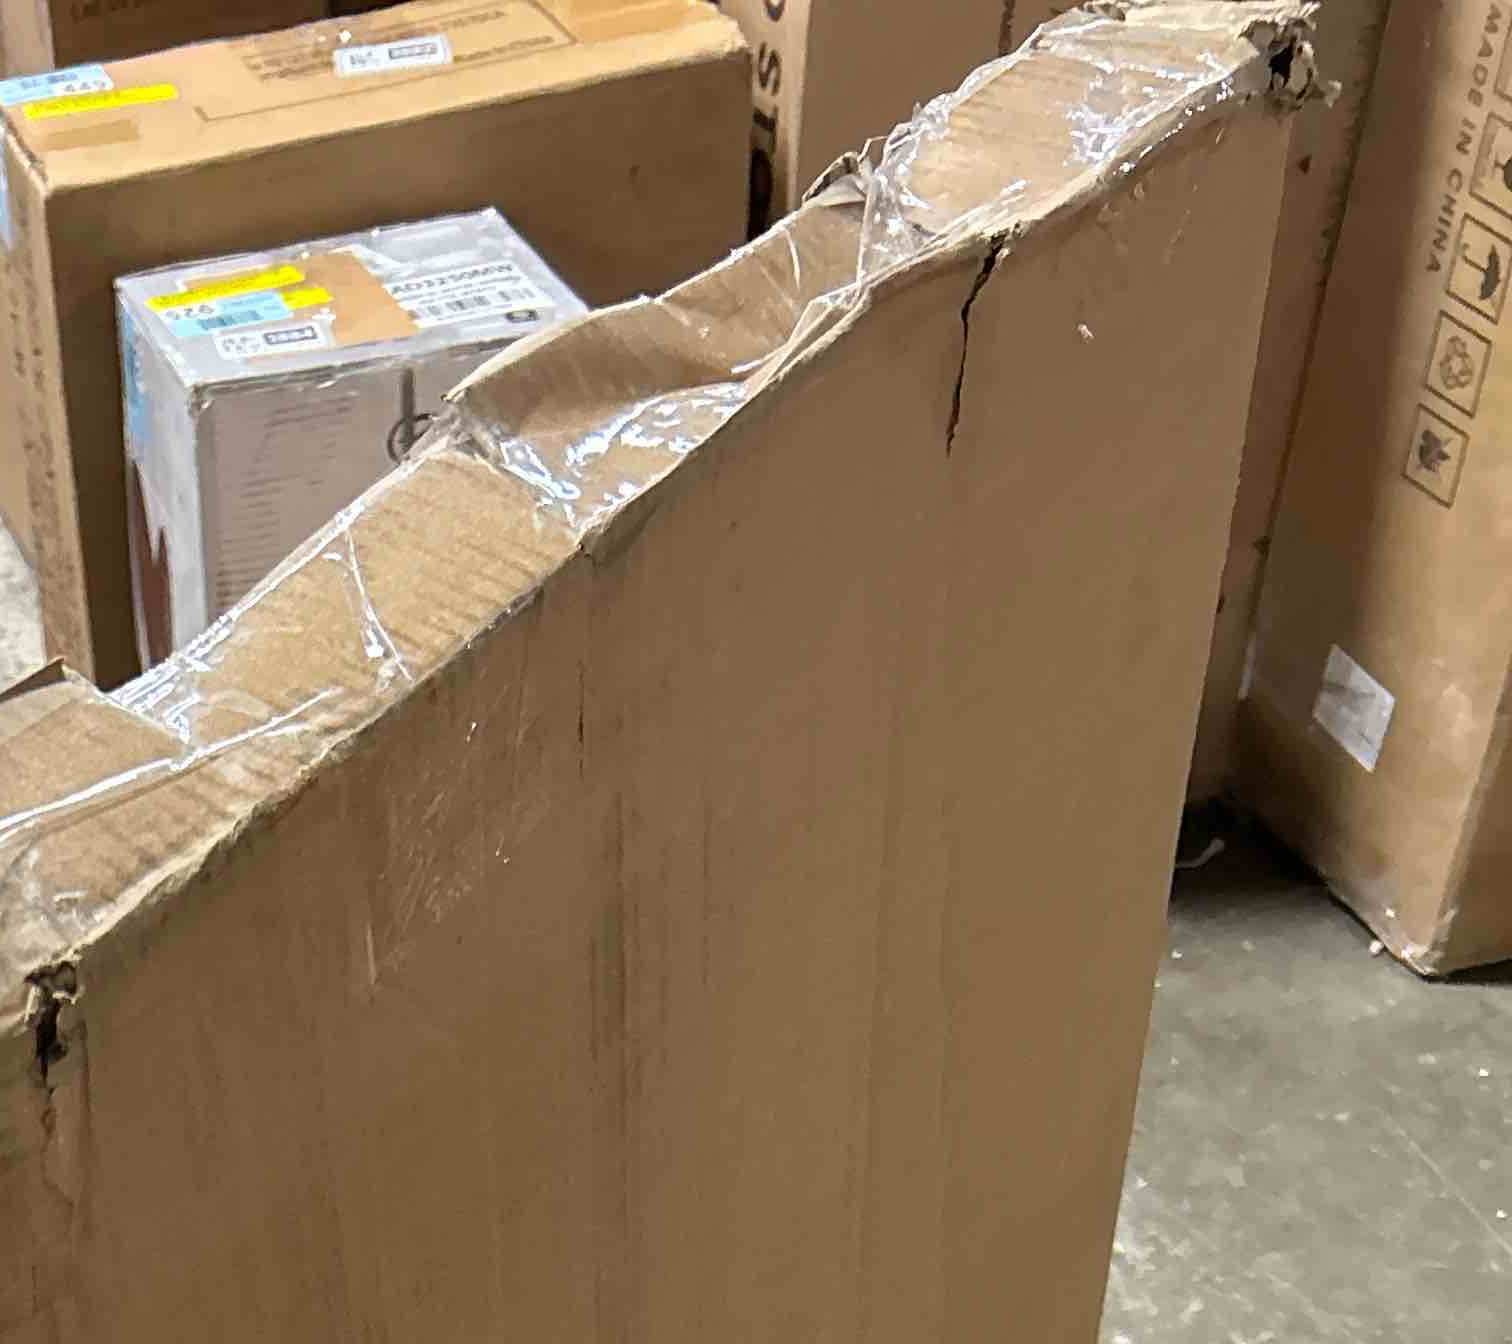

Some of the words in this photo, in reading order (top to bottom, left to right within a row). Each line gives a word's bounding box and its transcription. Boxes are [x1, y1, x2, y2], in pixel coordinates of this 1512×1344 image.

[1467, 2, 1502, 107] MADE
[1455, 117, 1477, 155] IN
[1426, 168, 1464, 272] CHINA
